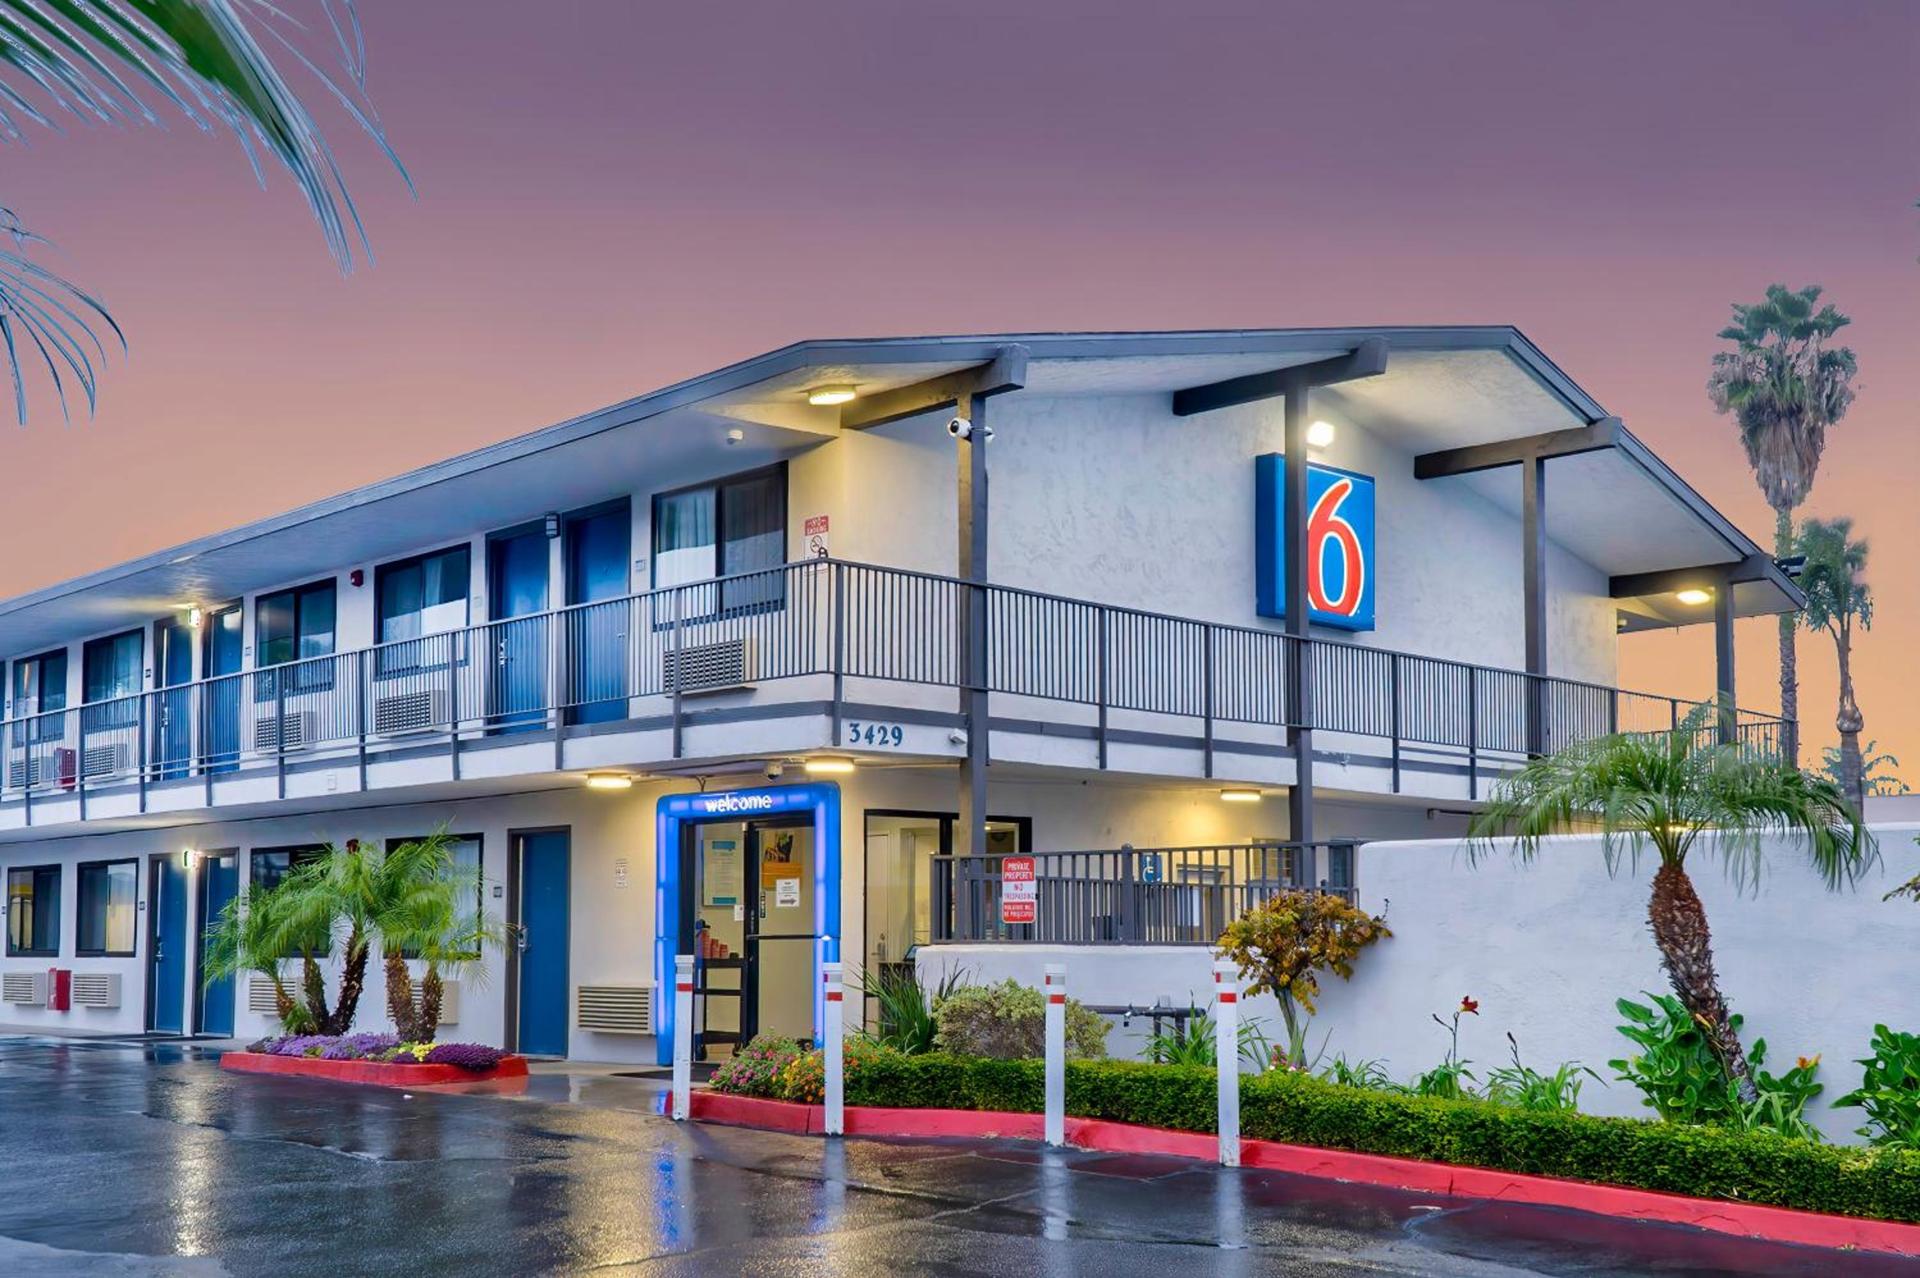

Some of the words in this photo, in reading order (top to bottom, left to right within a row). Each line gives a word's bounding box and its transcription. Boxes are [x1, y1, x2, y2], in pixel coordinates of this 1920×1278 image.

[1307, 478, 1365, 617] 6
[849, 722, 903, 747] 3429
[705, 794, 773, 813] welcome
[1007, 862, 1030, 871] PRIVATE
[1004, 871, 1034, 880] PROPERTY
[1013, 882, 1024, 891] NO
